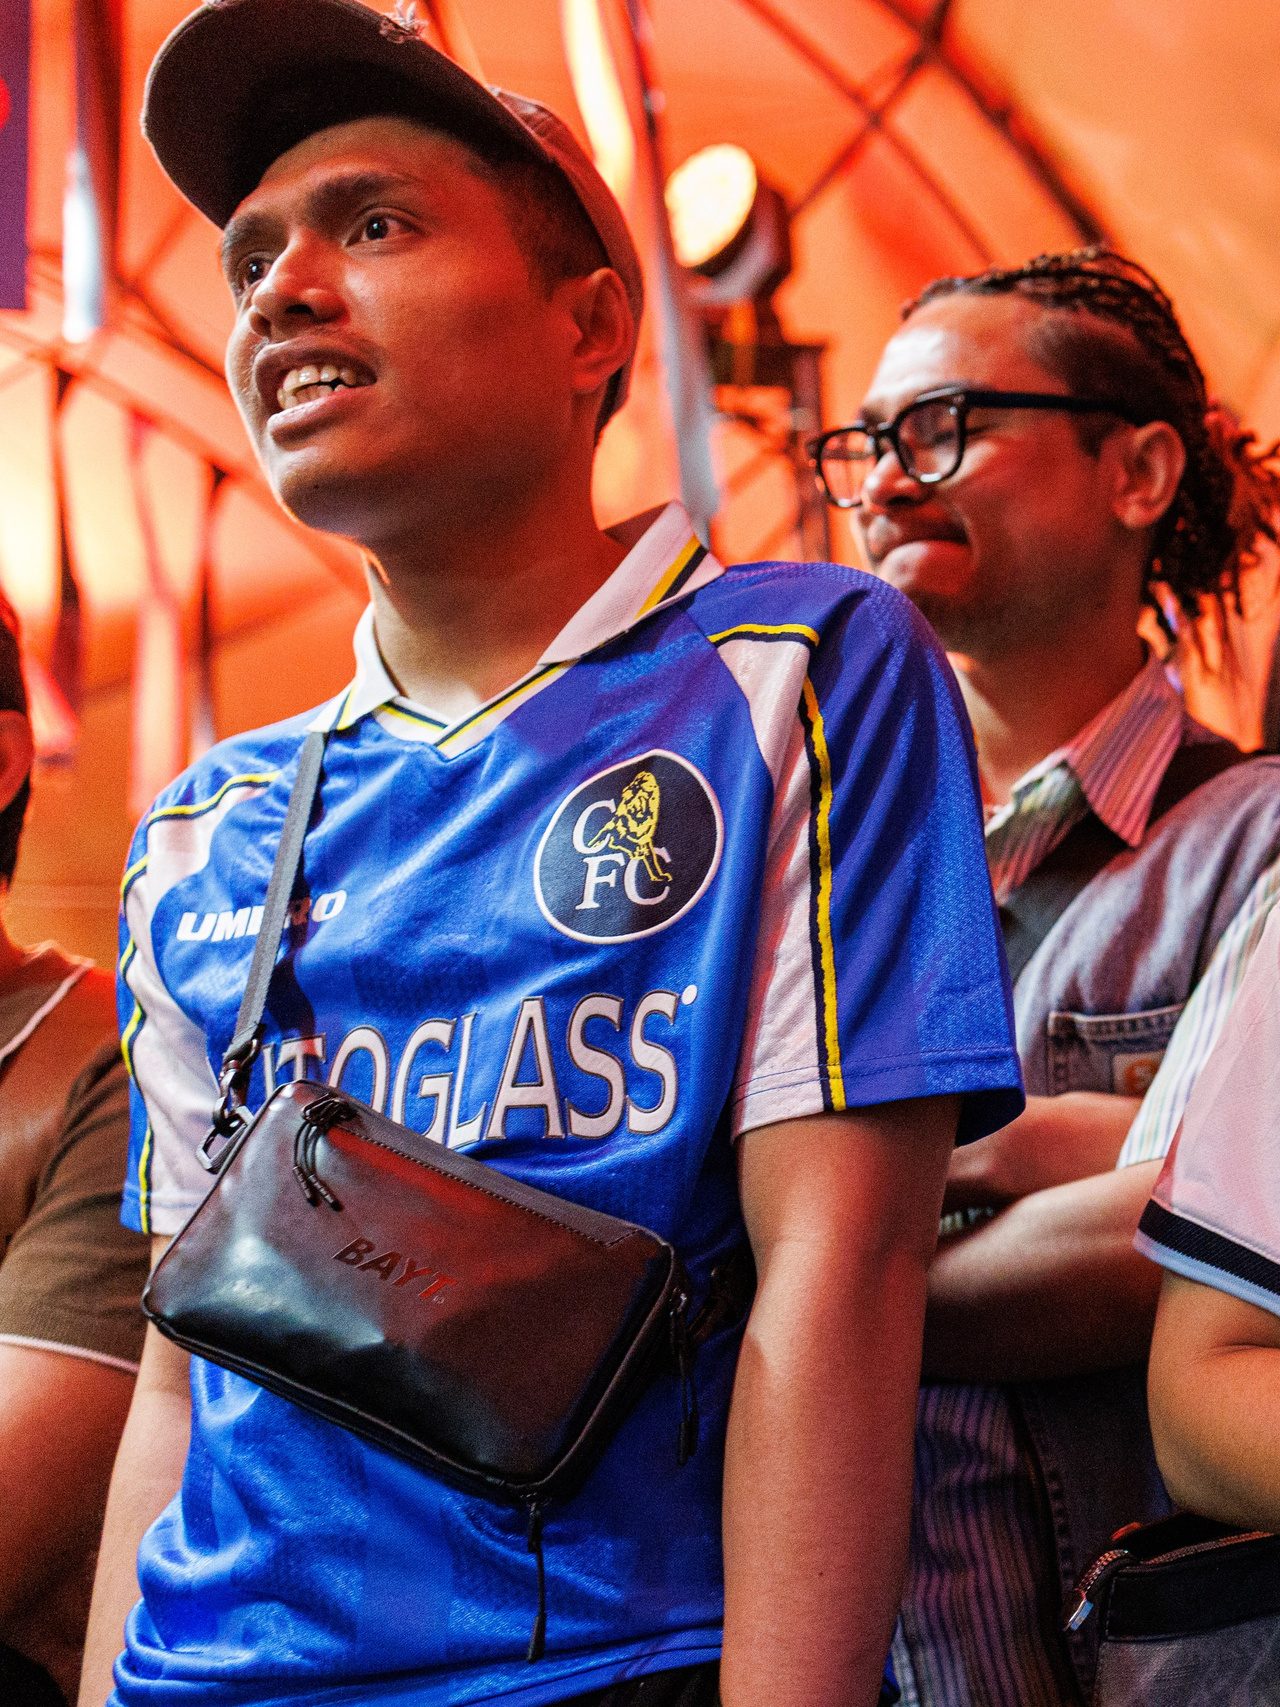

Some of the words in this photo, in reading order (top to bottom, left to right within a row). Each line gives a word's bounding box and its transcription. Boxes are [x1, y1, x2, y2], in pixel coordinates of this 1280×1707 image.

[176, 889, 348, 943] UMO
[260, 989, 681, 1151] TOGLASS
[331, 1236, 458, 1299] BAYT
